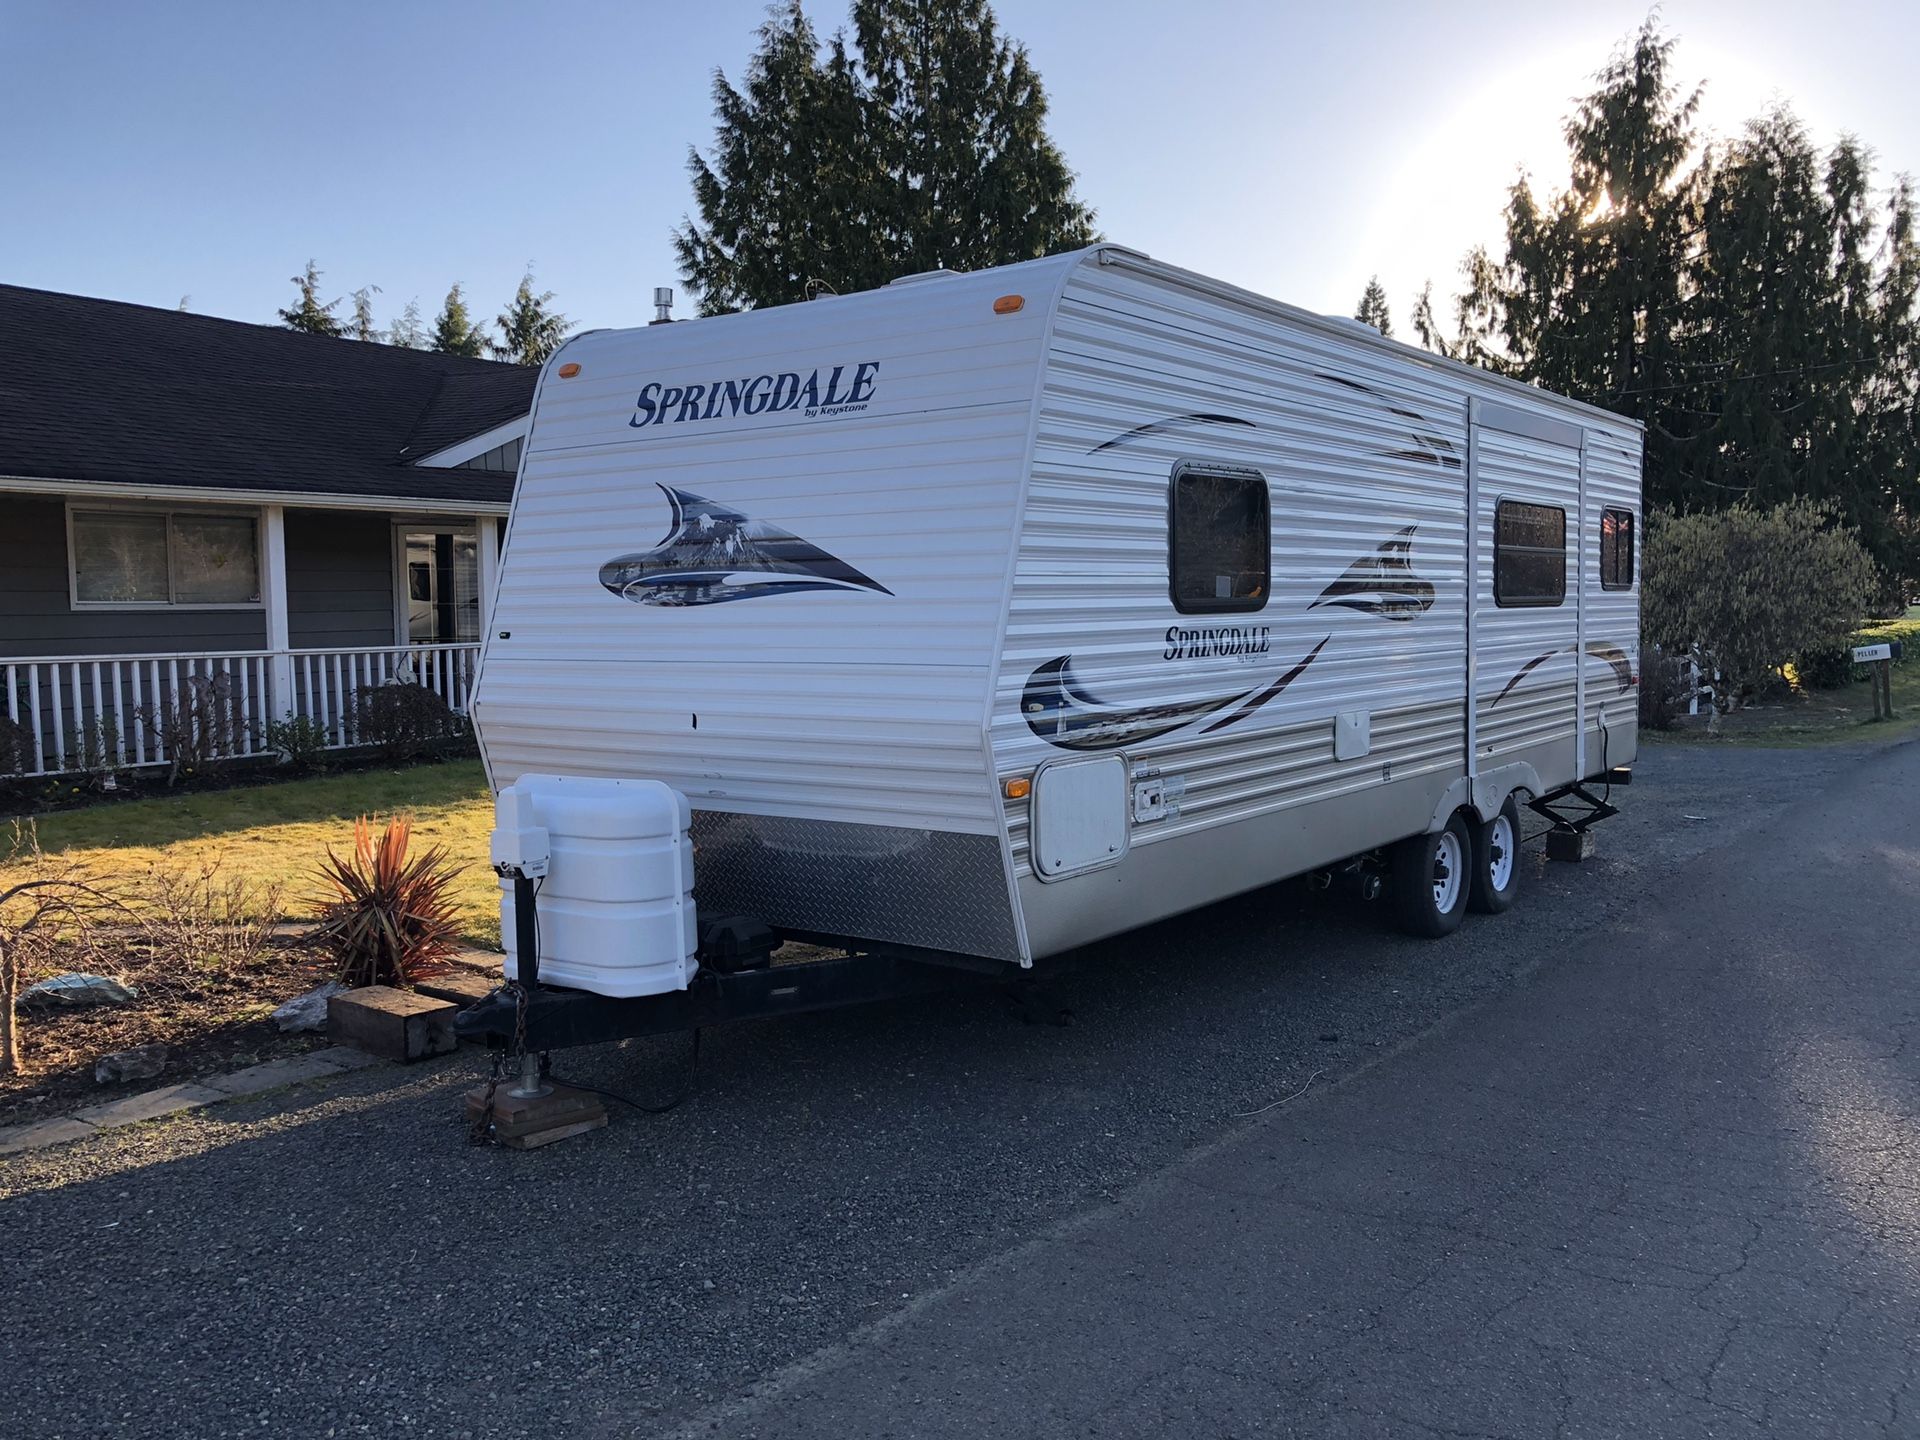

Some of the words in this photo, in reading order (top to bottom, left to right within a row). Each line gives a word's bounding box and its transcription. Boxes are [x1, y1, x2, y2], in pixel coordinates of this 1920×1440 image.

[629, 362, 880, 428] SPRINGDALE
[804, 408, 818, 418] by
[820, 404, 868, 416] Keystone
[1163, 626, 1270, 660] SPRINGDALE
